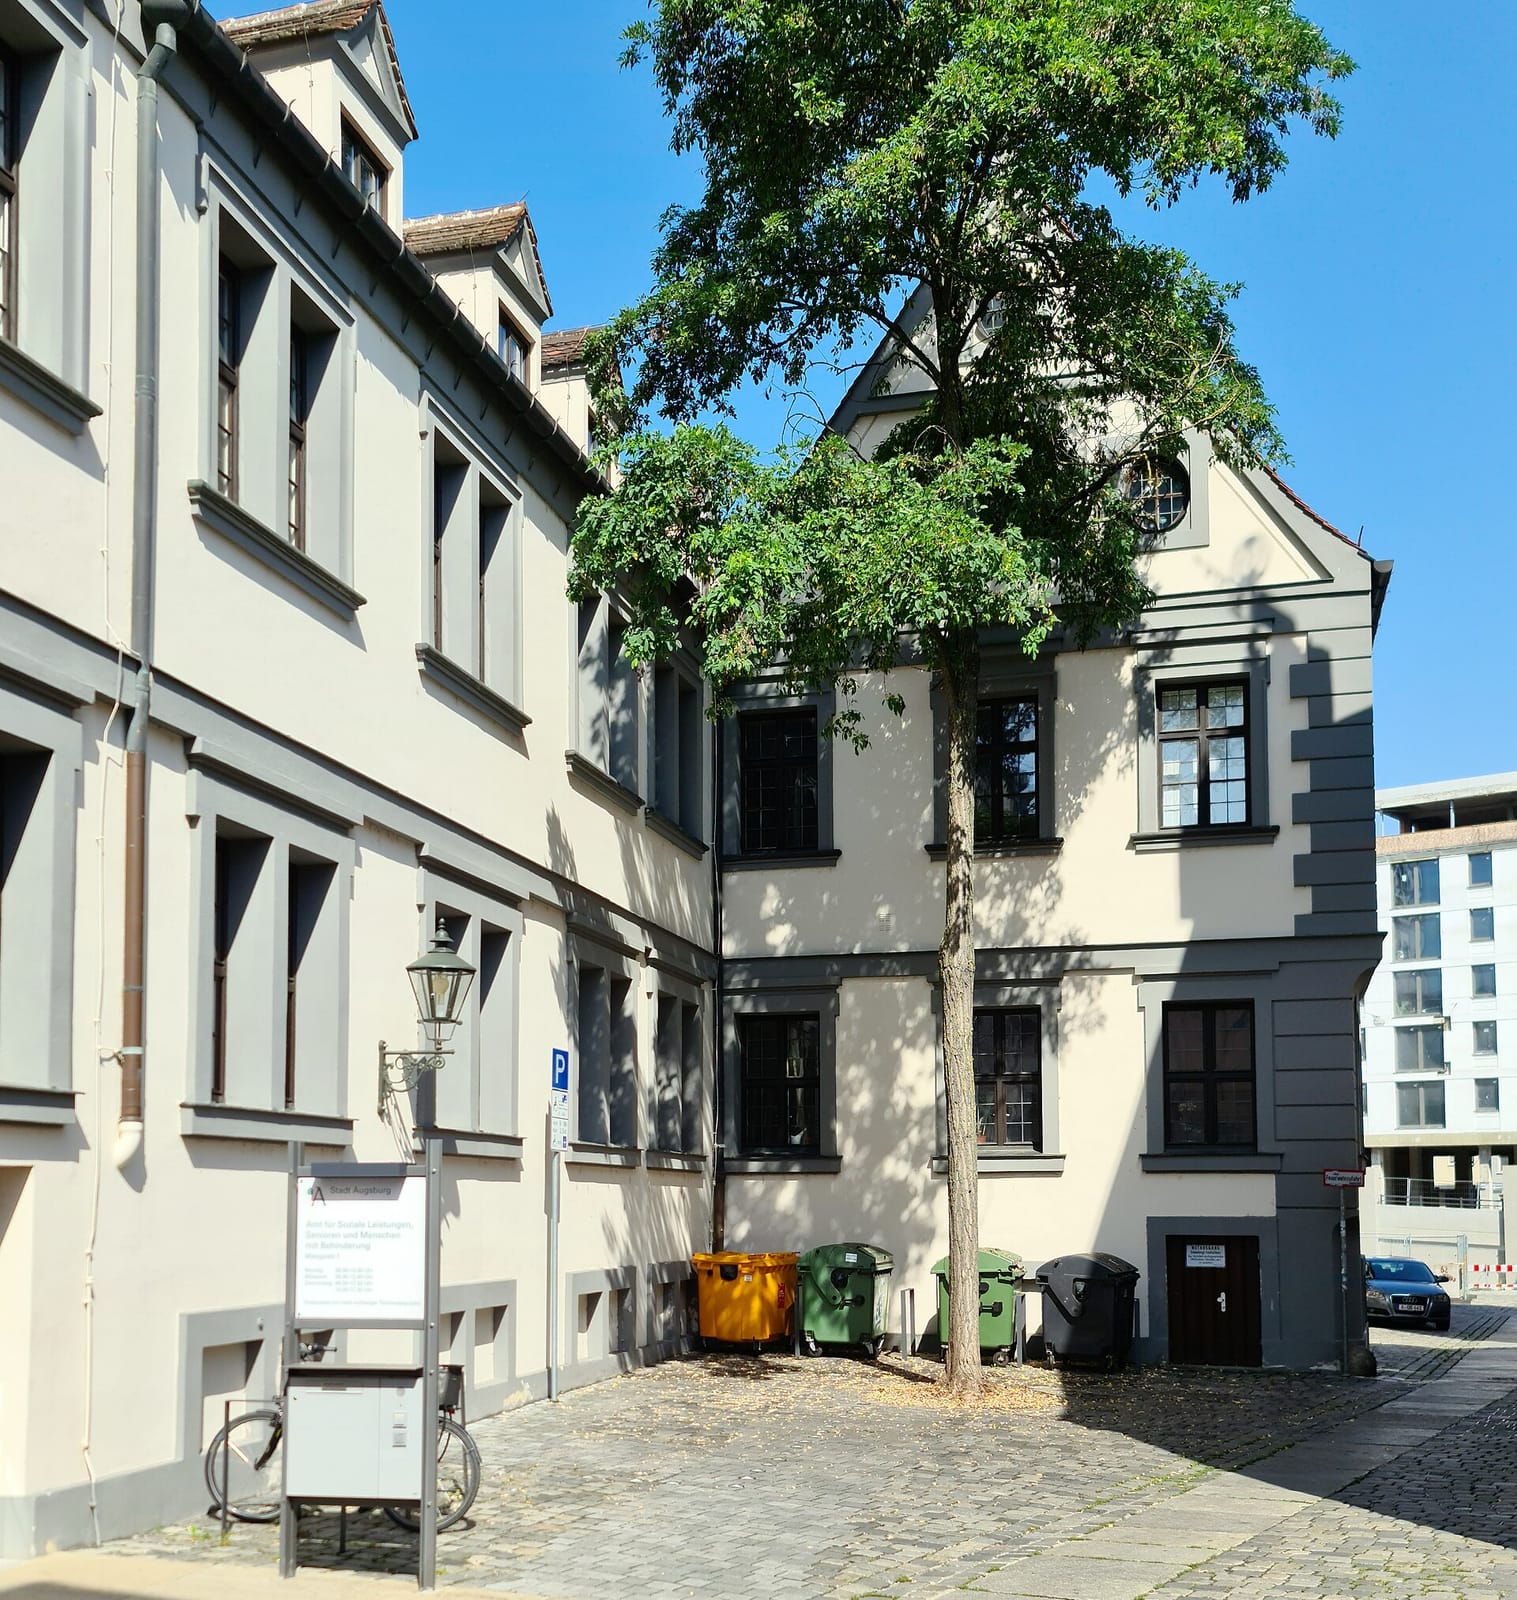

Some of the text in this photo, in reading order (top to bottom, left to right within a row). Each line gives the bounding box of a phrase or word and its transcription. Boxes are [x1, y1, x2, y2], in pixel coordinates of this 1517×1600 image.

[556, 1054, 566, 1084] P
[330, 1186, 392, 1195] Stadt Augsburg
[337, 1220, 366, 1229] Soziale
[305, 1230, 401, 1239] Senioren und Menschen
[304, 1241, 371, 1251] mit Behinderung
